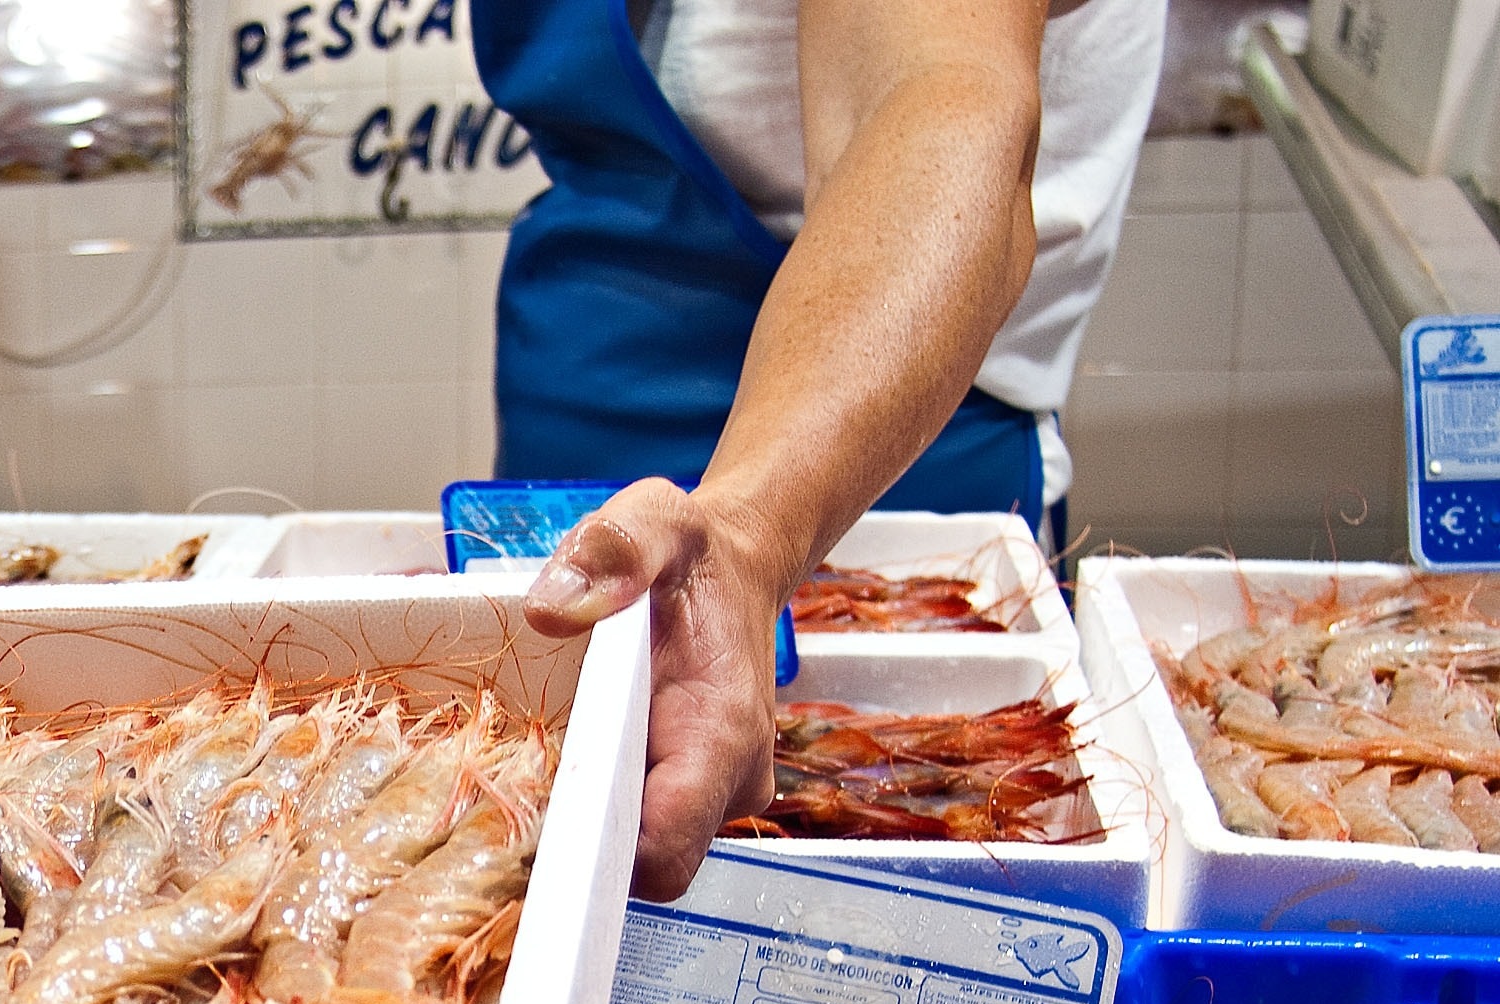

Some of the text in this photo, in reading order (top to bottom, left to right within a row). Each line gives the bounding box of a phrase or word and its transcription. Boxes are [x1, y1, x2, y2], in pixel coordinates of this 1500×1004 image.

[232, 0, 458, 90] PESCA
[809, 957, 827, 972] DE
[994, 992, 1009, 1002] DE
